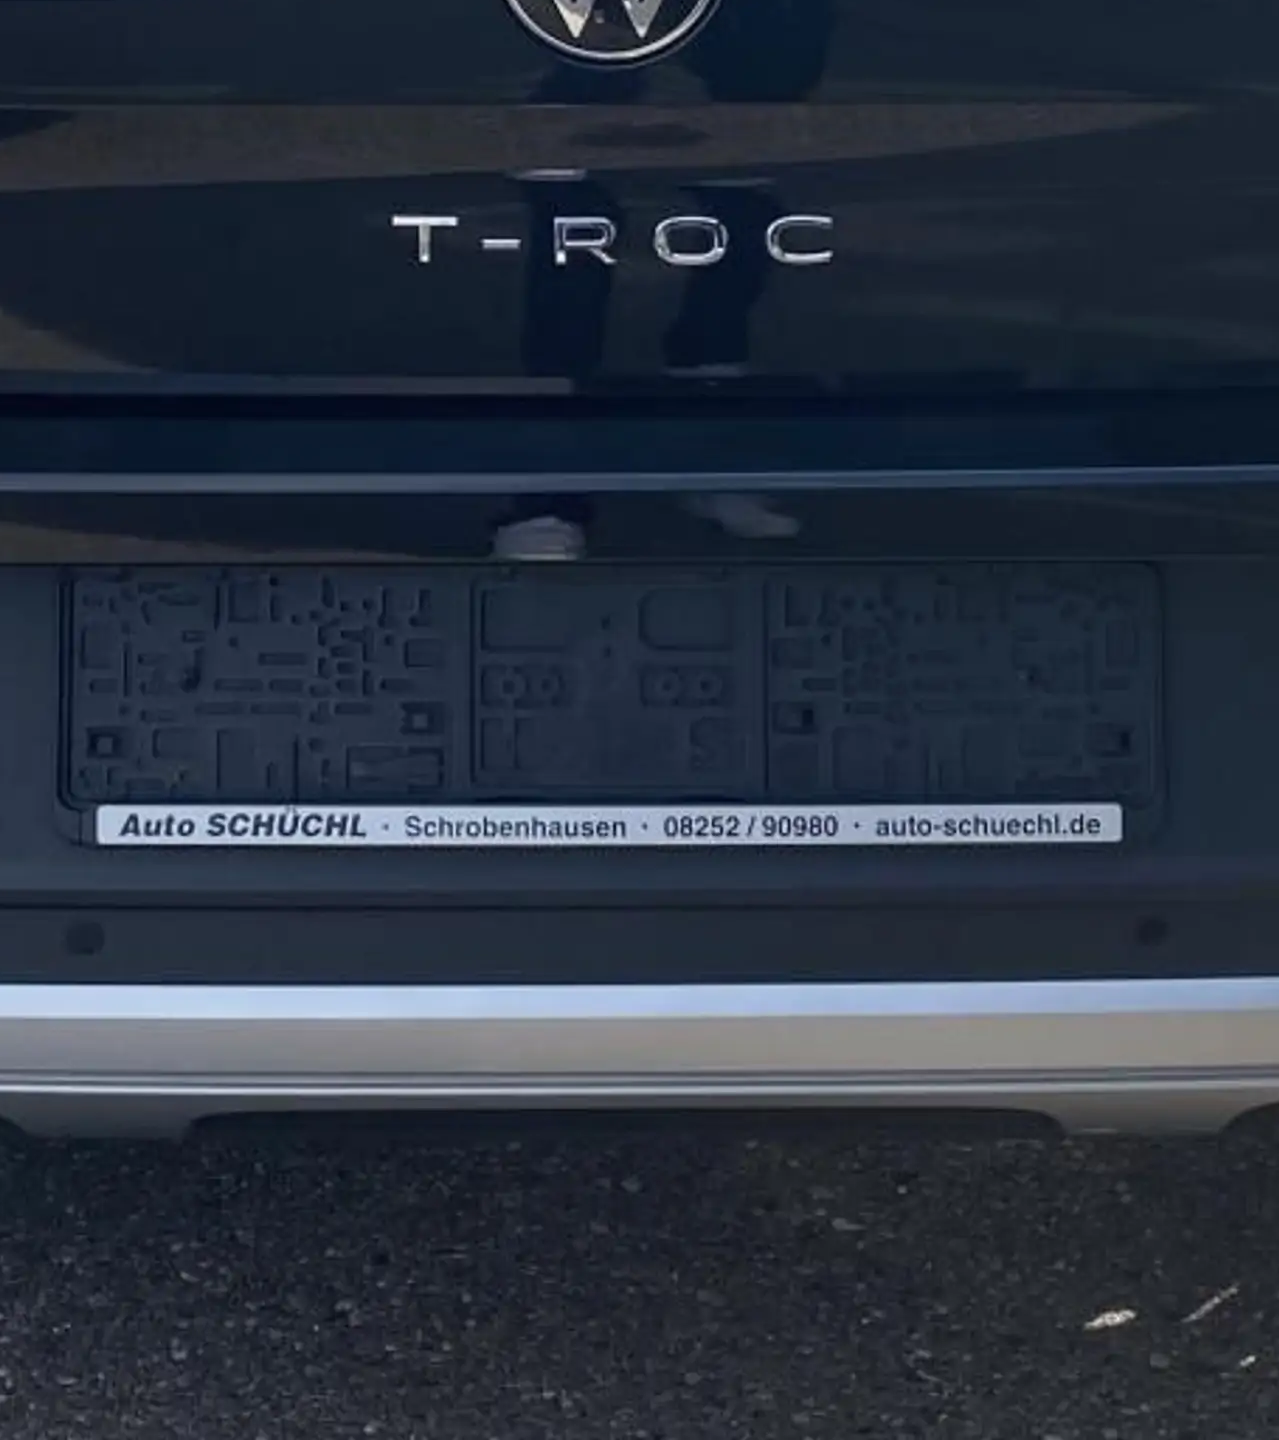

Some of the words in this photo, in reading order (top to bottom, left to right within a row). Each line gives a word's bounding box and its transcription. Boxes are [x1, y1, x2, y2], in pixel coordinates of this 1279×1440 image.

[391, 215, 833, 265] T-ROC
[119, 813, 196, 837] Auto
[206, 806, 367, 837] SCHÜCHL
[405, 815, 627, 838] Schrobenhausen
[875, 813, 1101, 837] auto-schuechl.de
